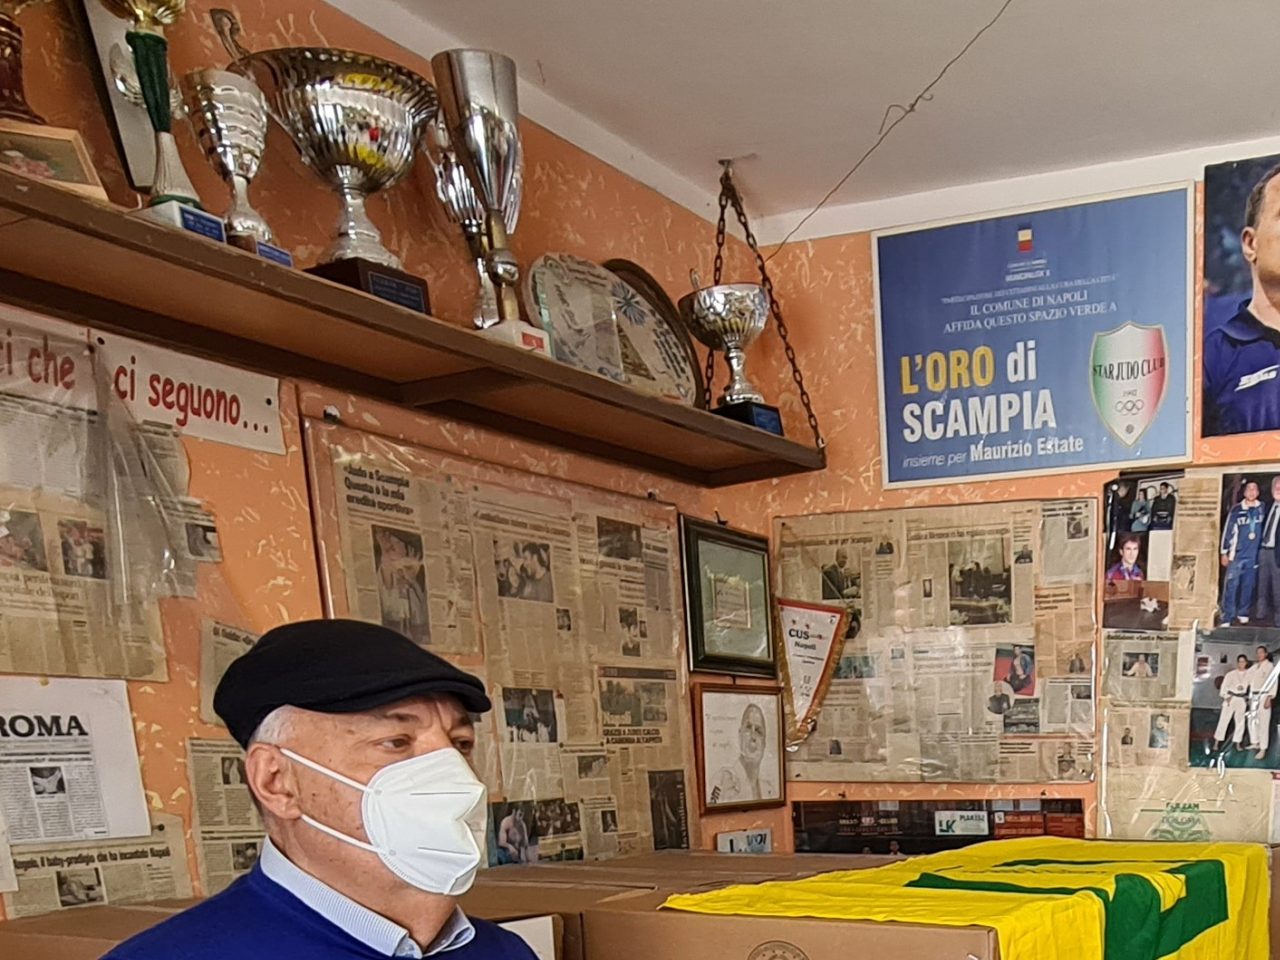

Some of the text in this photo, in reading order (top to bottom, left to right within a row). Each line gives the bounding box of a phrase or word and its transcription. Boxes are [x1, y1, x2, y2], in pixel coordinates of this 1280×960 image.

[944, 302, 1117, 334] AFFIDA QUESTO SPAZIO VERDE A
[970, 290, 1088, 316] IL COMUNE DI NAPOLI
[901, 340, 1036, 395] L'ORO di
[1093, 357, 1165, 381] STAR JUDO CLUB
[28, 335, 75, 390] che
[114, 355, 136, 400] ci
[148, 373, 269, 433] seguono...
[903, 389, 1057, 442] SCAMPIA
[903, 435, 1084, 468] insieme per Maurizio Estate
[789, 628, 810, 640] CUS
